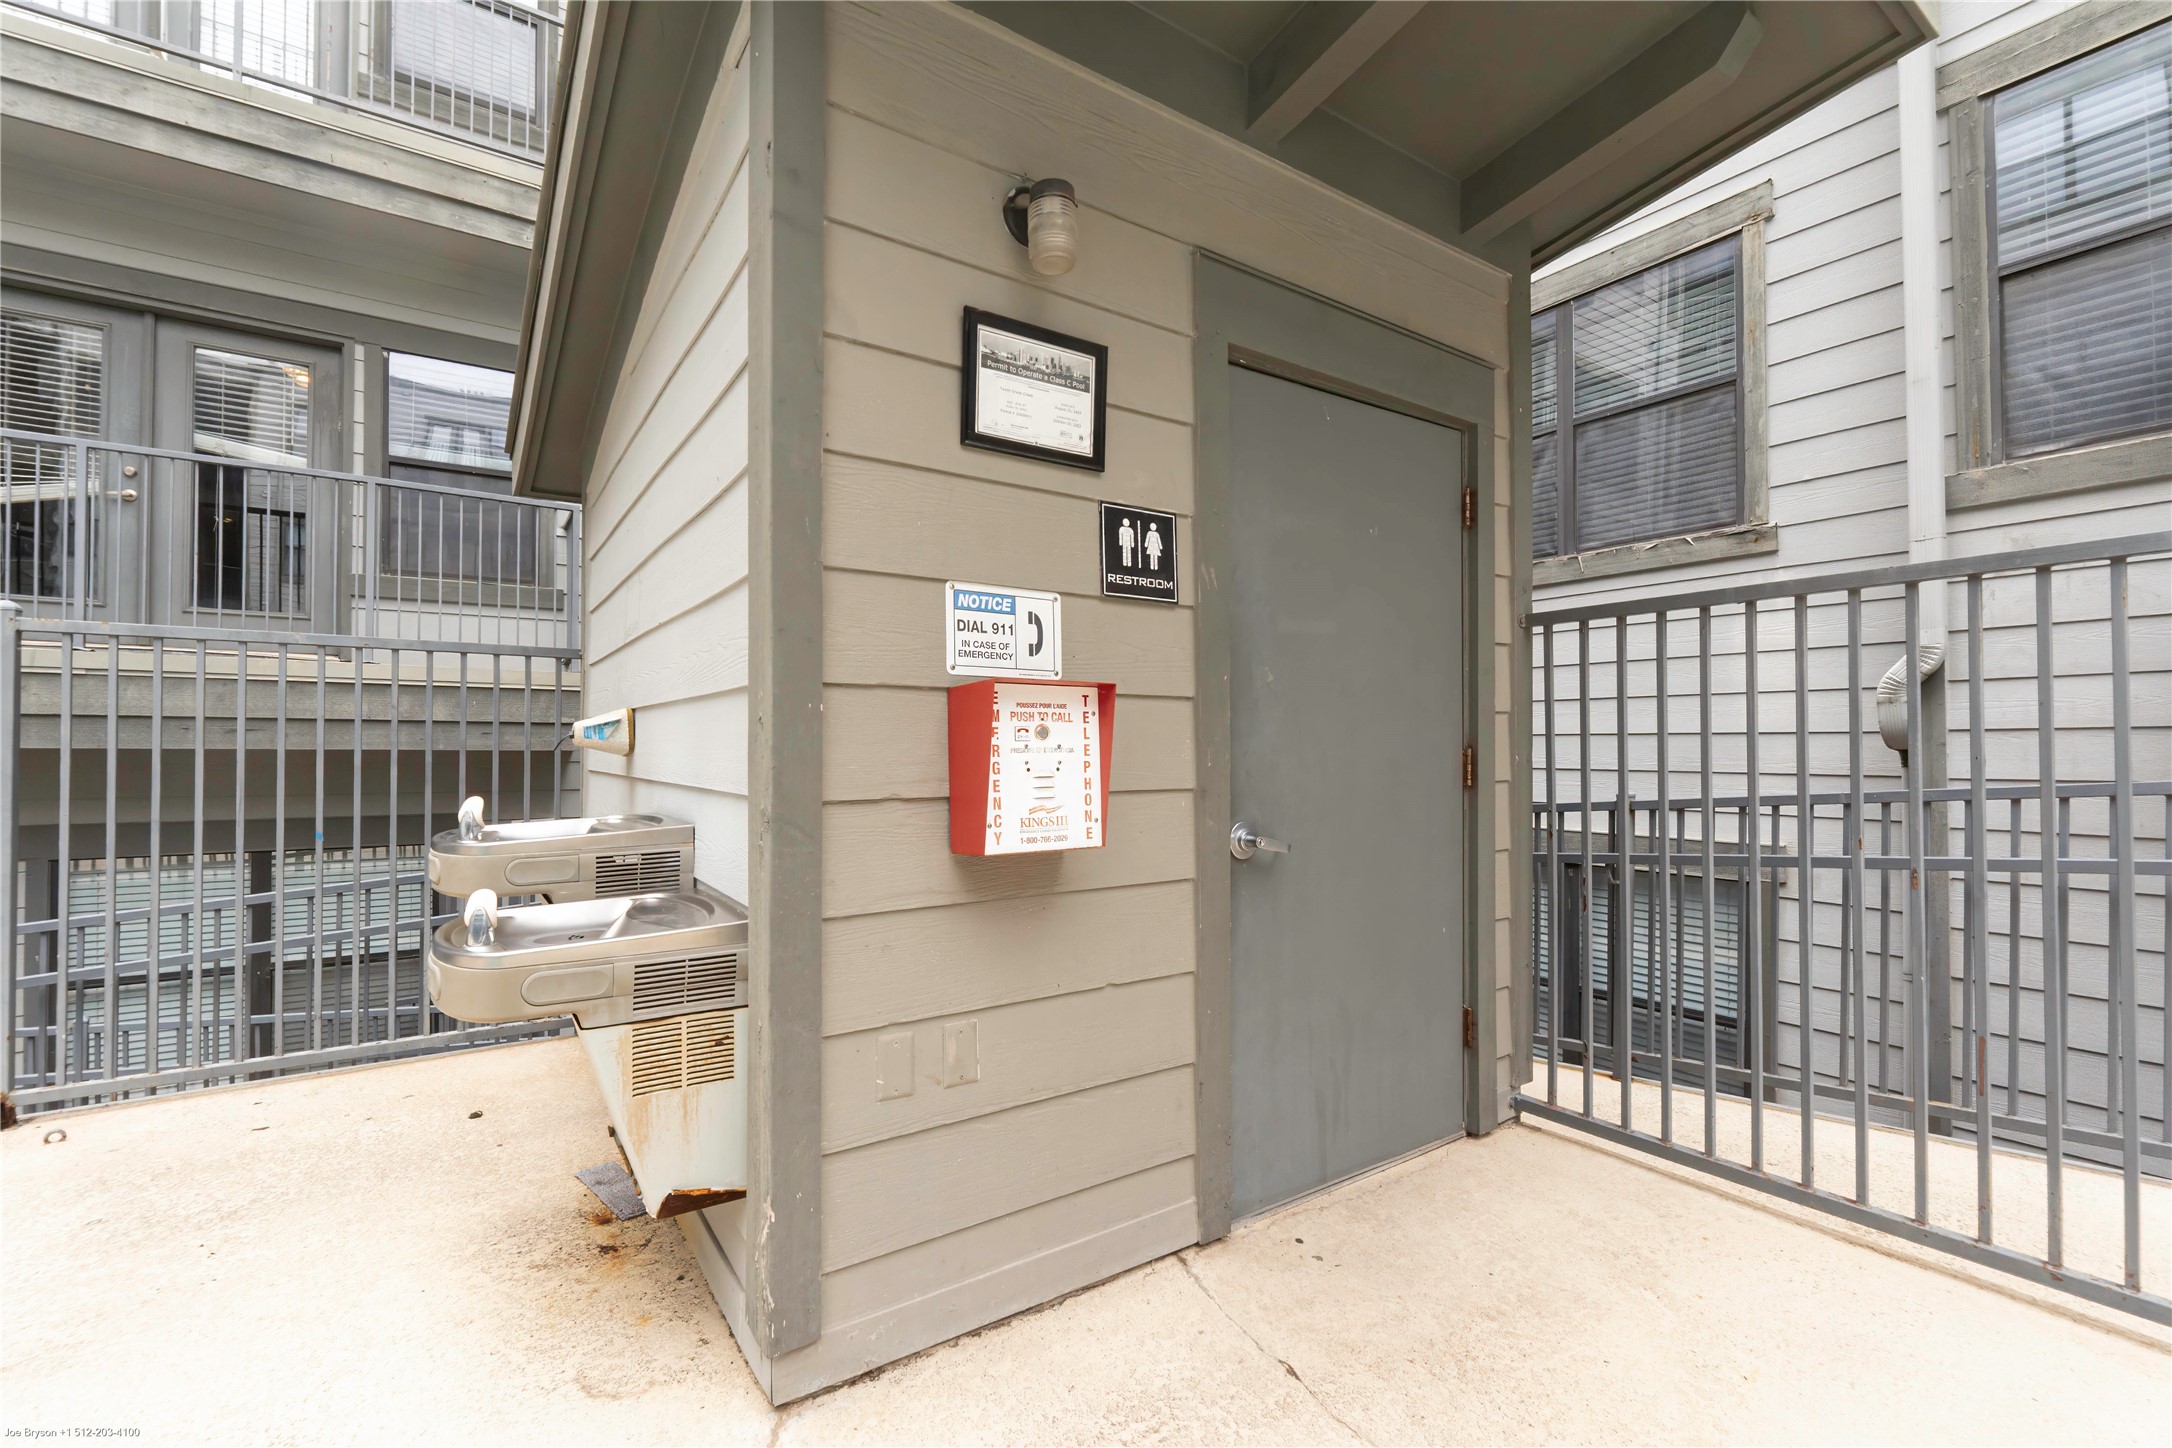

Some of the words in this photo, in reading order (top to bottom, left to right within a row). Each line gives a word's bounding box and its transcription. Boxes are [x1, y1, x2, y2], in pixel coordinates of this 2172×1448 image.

[987, 360, 1009, 371] Permit
[1018, 368, 1043, 380] Operate
[1049, 375, 1066, 385] Class
[1072, 381, 1085, 390] Pool
[1107, 573, 1174, 590] RESTROOM
[957, 593, 1012, 612] NOTICE
[956, 619, 987, 634] DIAL
[991, 623, 1014, 636] 911
[961, 639, 970, 648] IN
[973, 640, 996, 650] CASE
[999, 642, 1010, 651] OF
[958, 649, 1014, 661] EMERGENCY
[1009, 711, 1035, 722] PUSH
[1037, 711, 1049, 722] TO
[1051, 712, 1073, 723] CALL
[1082, 694, 1093, 839] TELEPHONE
[1020, 817, 1055, 828] KINGS
[1056, 815, 1069, 826] III
